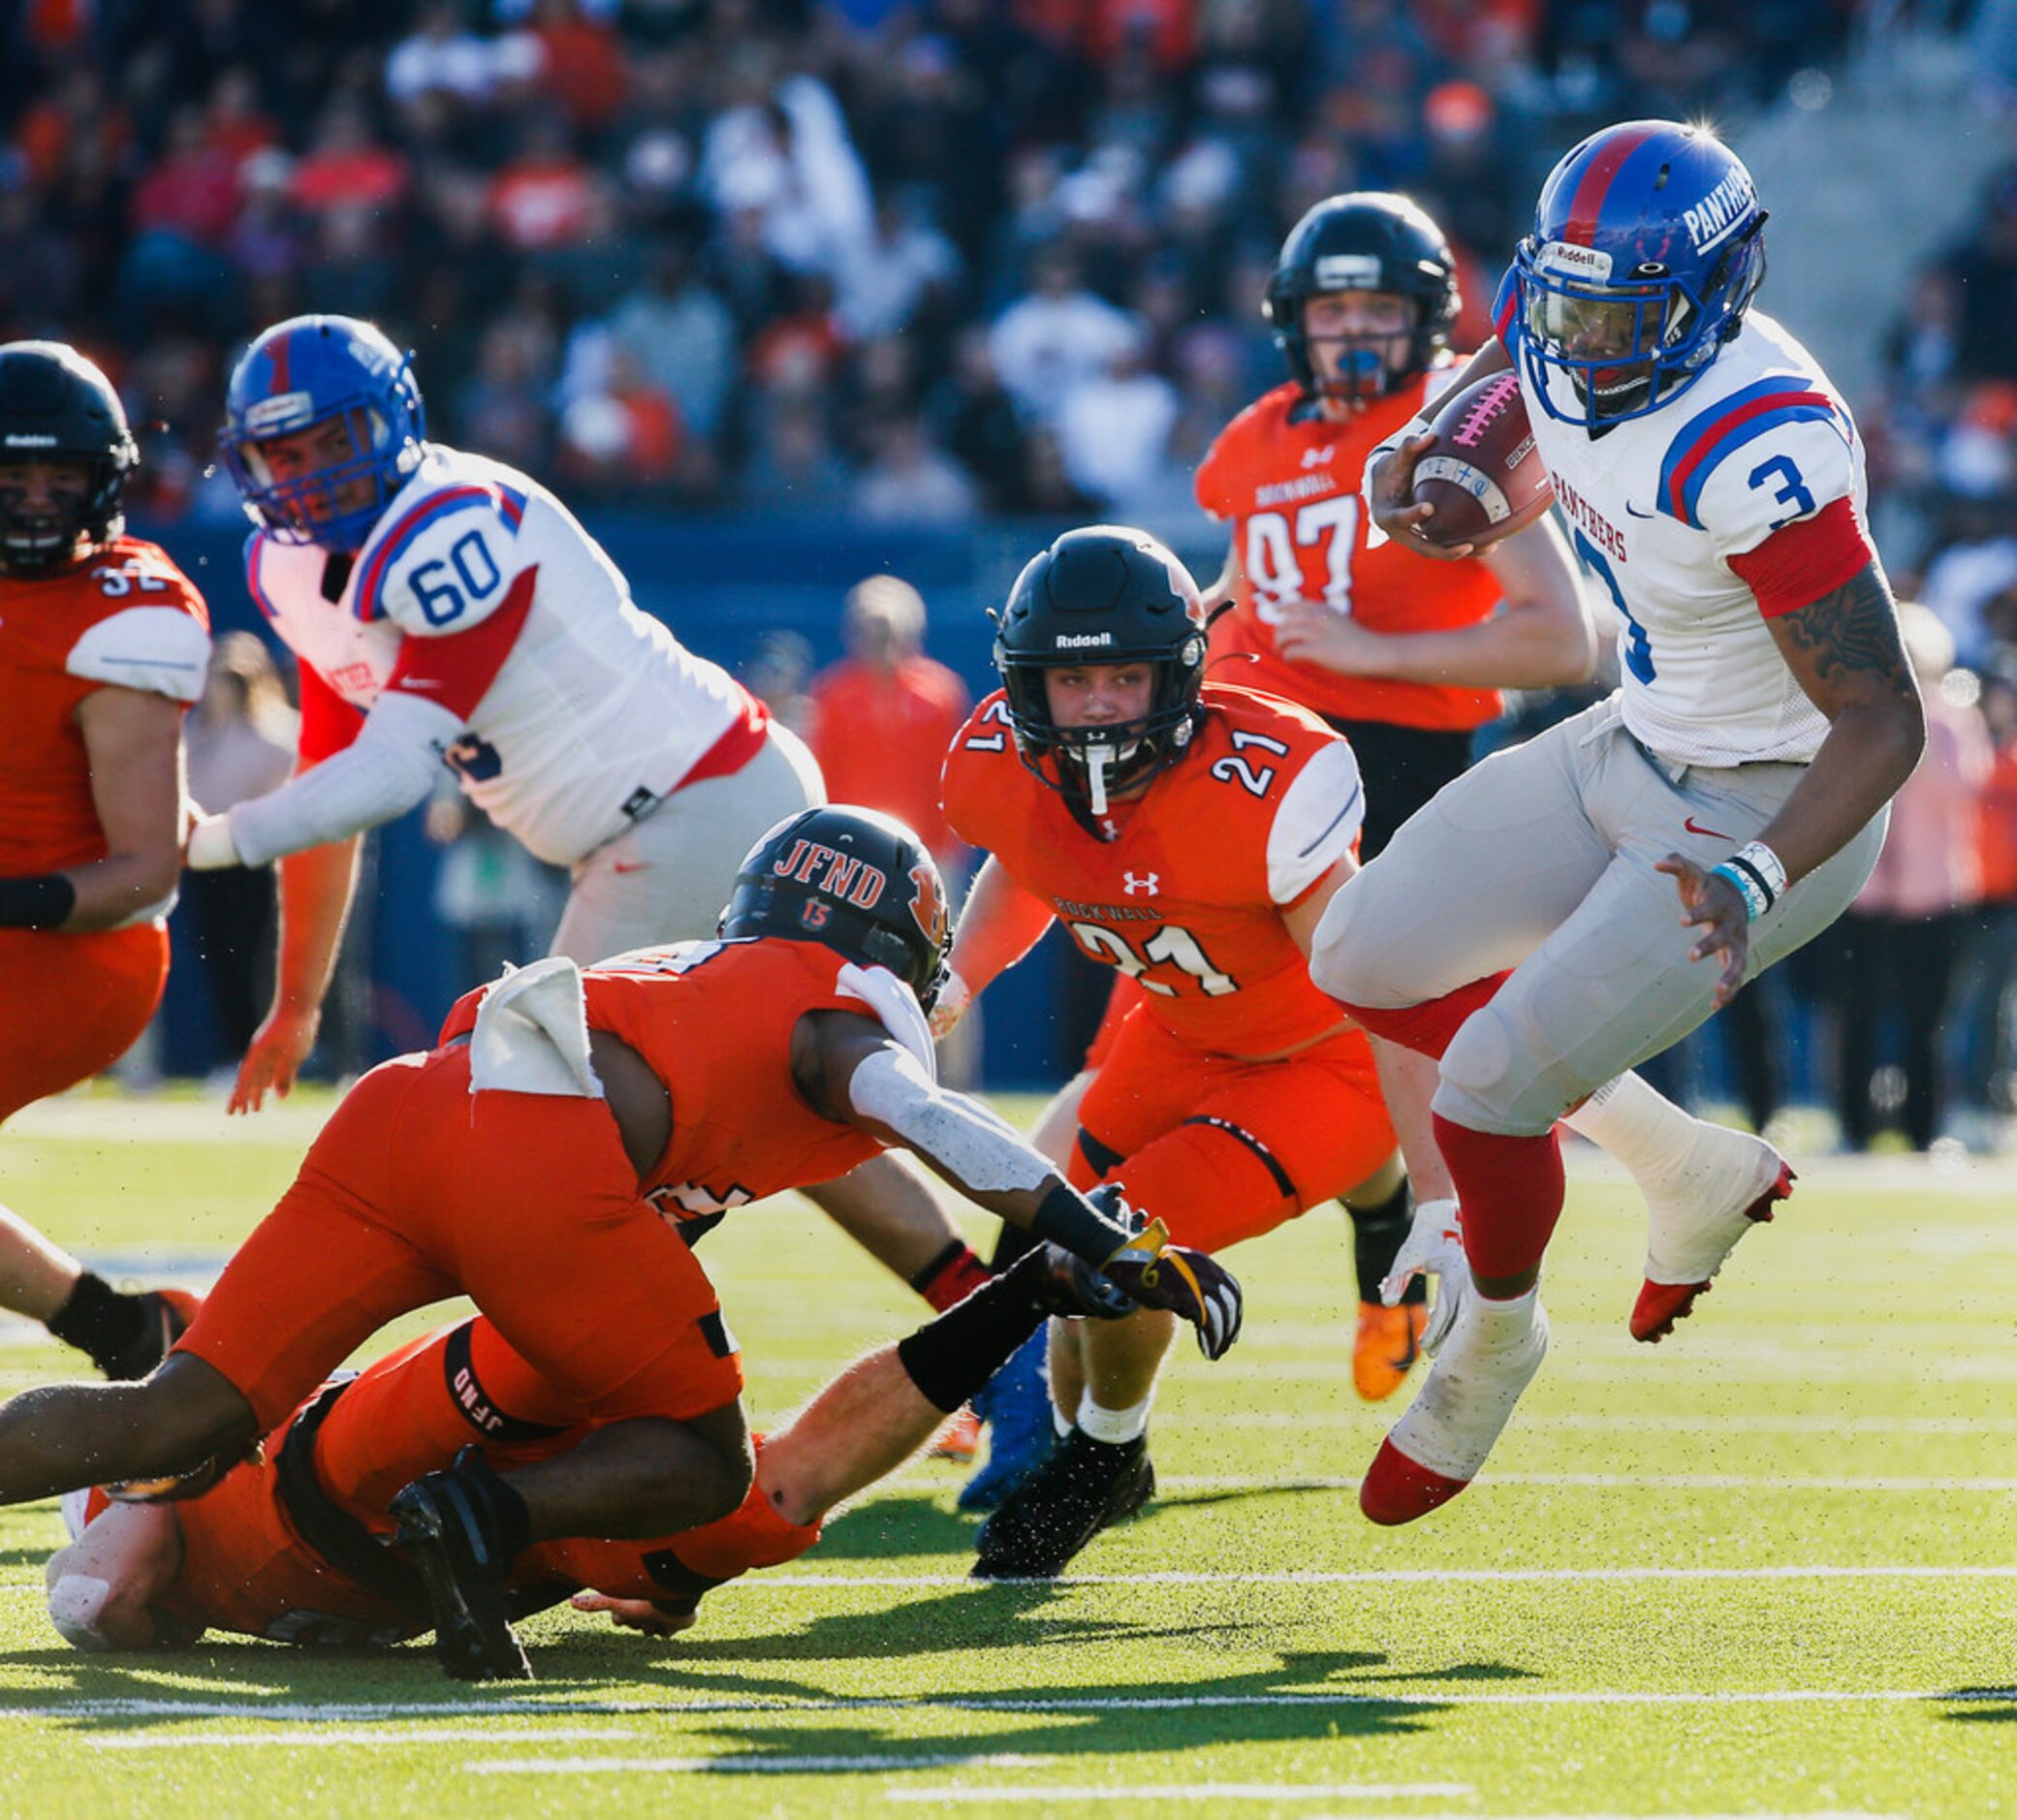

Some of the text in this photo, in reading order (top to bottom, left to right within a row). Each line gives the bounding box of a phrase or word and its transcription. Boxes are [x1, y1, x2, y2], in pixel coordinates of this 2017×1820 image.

[1558, 246, 1595, 265] Riddell
[1551, 470, 1627, 562] PANTHERS
[1748, 455, 1816, 531] 3
[91, 557, 169, 597] 32
[408, 529, 501, 626] 60
[1246, 493, 1358, 625] 97
[1056, 632, 1112, 648] Riddell
[1211, 728, 1290, 800] 21
[773, 838, 886, 911] JFND
[1054, 895, 1162, 922] ROCKWALL
[1069, 922, 1241, 998] 21
[454, 1366, 503, 1430] JFND
